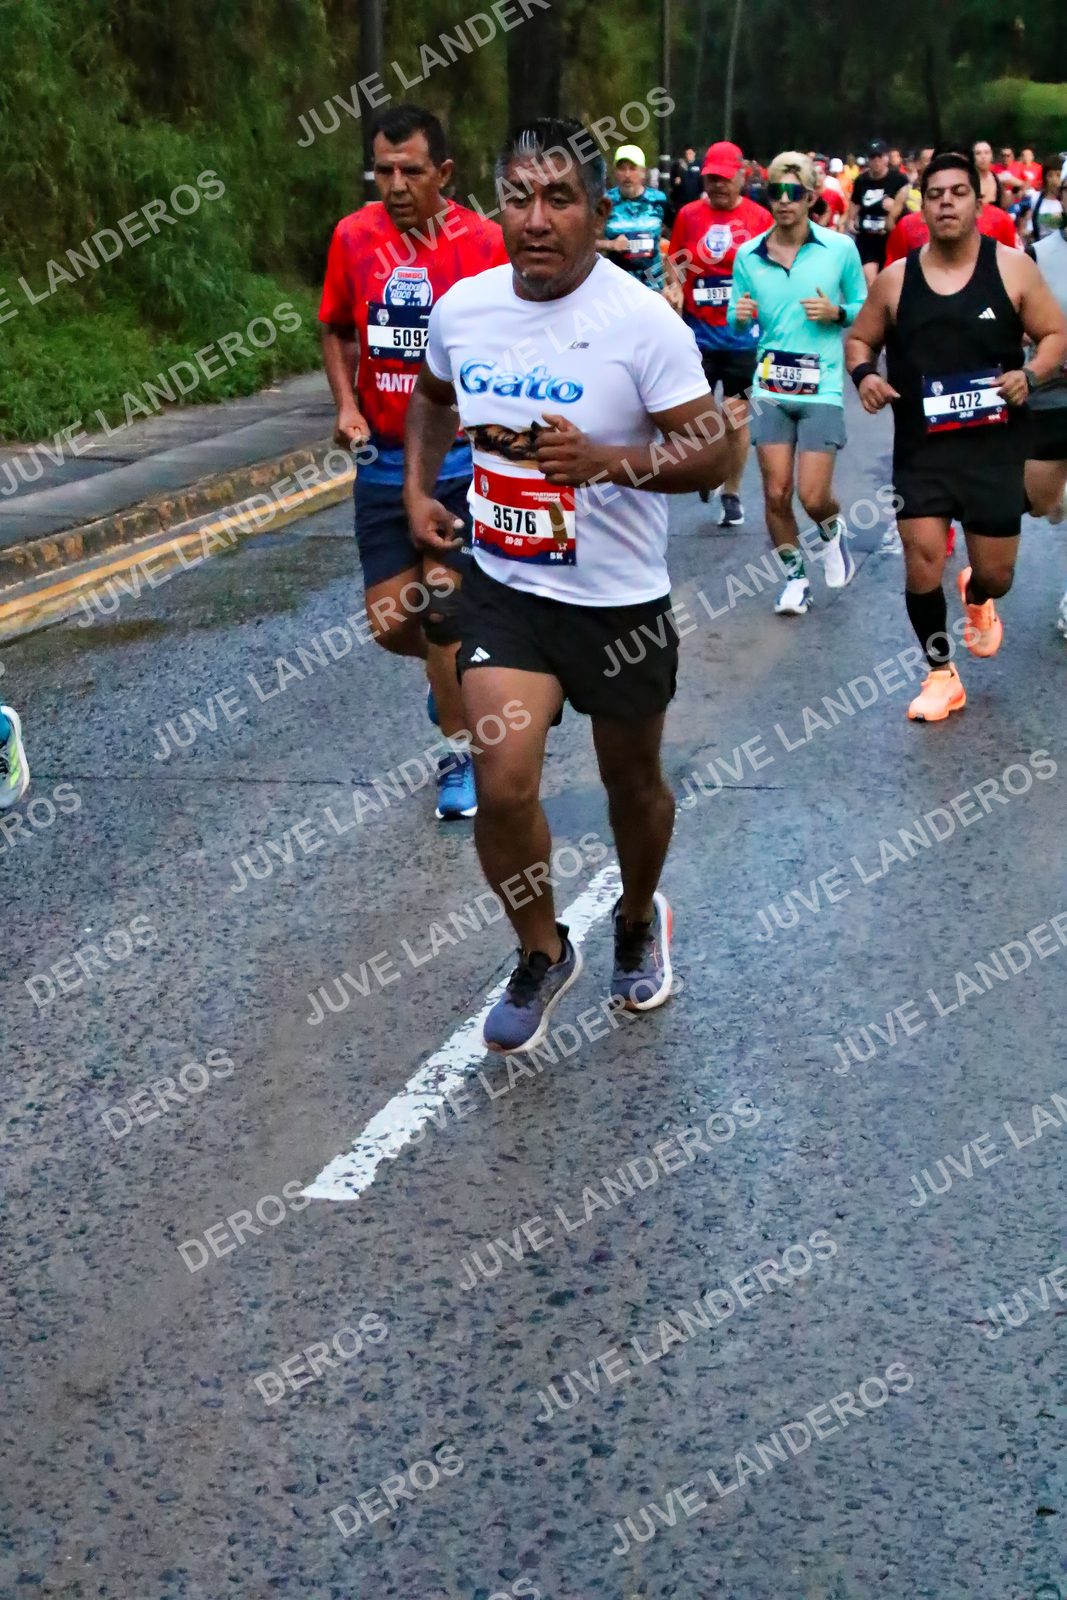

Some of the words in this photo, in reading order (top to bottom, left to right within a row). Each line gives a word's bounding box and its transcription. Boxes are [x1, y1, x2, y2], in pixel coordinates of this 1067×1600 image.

[391, 290, 411, 299] Race
[460, 358, 583, 404] Gato
[776, 367, 802, 380] 5435
[950, 392, 982, 410] 4472
[494, 504, 537, 535] 3576
